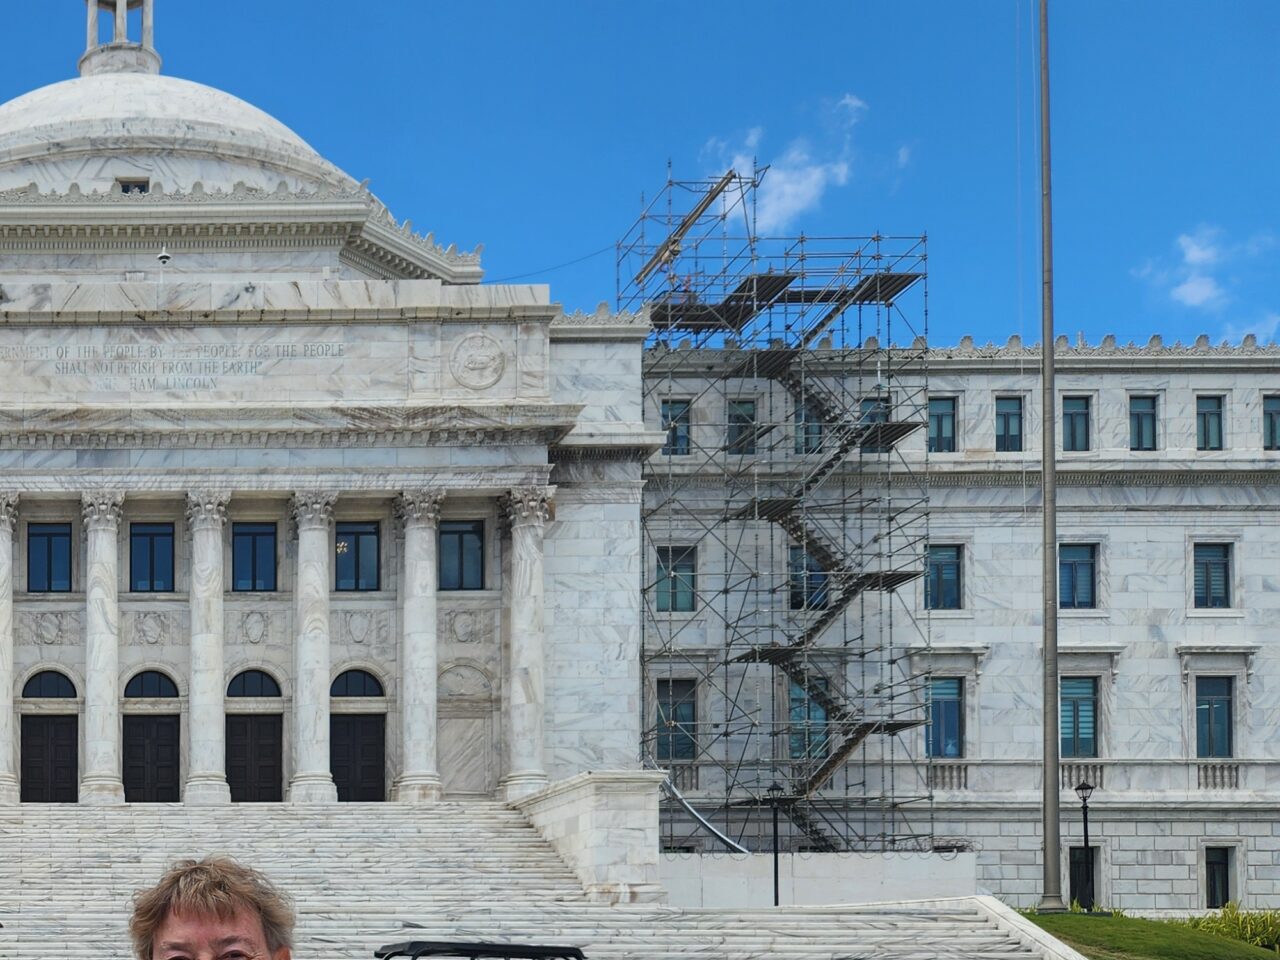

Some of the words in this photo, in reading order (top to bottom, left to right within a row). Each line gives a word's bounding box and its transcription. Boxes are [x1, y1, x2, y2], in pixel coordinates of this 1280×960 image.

[56, 346, 70, 359] OF
[76, 346, 97, 358] THE
[149, 345, 163, 358] BY
[275, 344, 297, 358] THE
[303, 344, 345, 357] PEOPLE
[54, 361, 87, 375] SHALL
[93, 361, 114, 375] NOT
[117, 361, 156, 375] PERISH
[162, 361, 193, 375] FROM
[198, 361, 219, 375] THE
